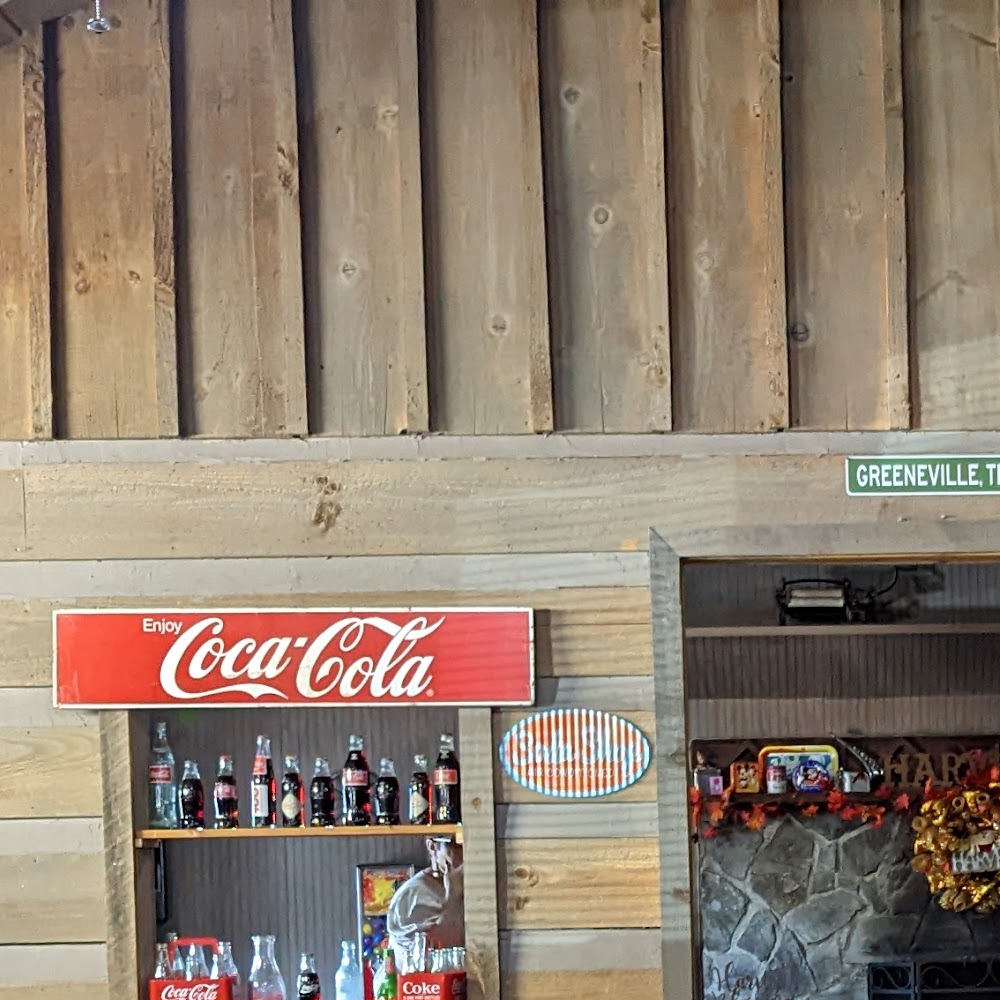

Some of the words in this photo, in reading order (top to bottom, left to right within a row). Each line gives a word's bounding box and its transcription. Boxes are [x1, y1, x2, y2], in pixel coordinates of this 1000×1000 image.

[856, 463, 983, 487] GREENEVILLE,
[142, 617, 183, 635] Enjoy
[159, 616, 446, 700] Coca-Cola
[402, 981, 440, 995] Coke
